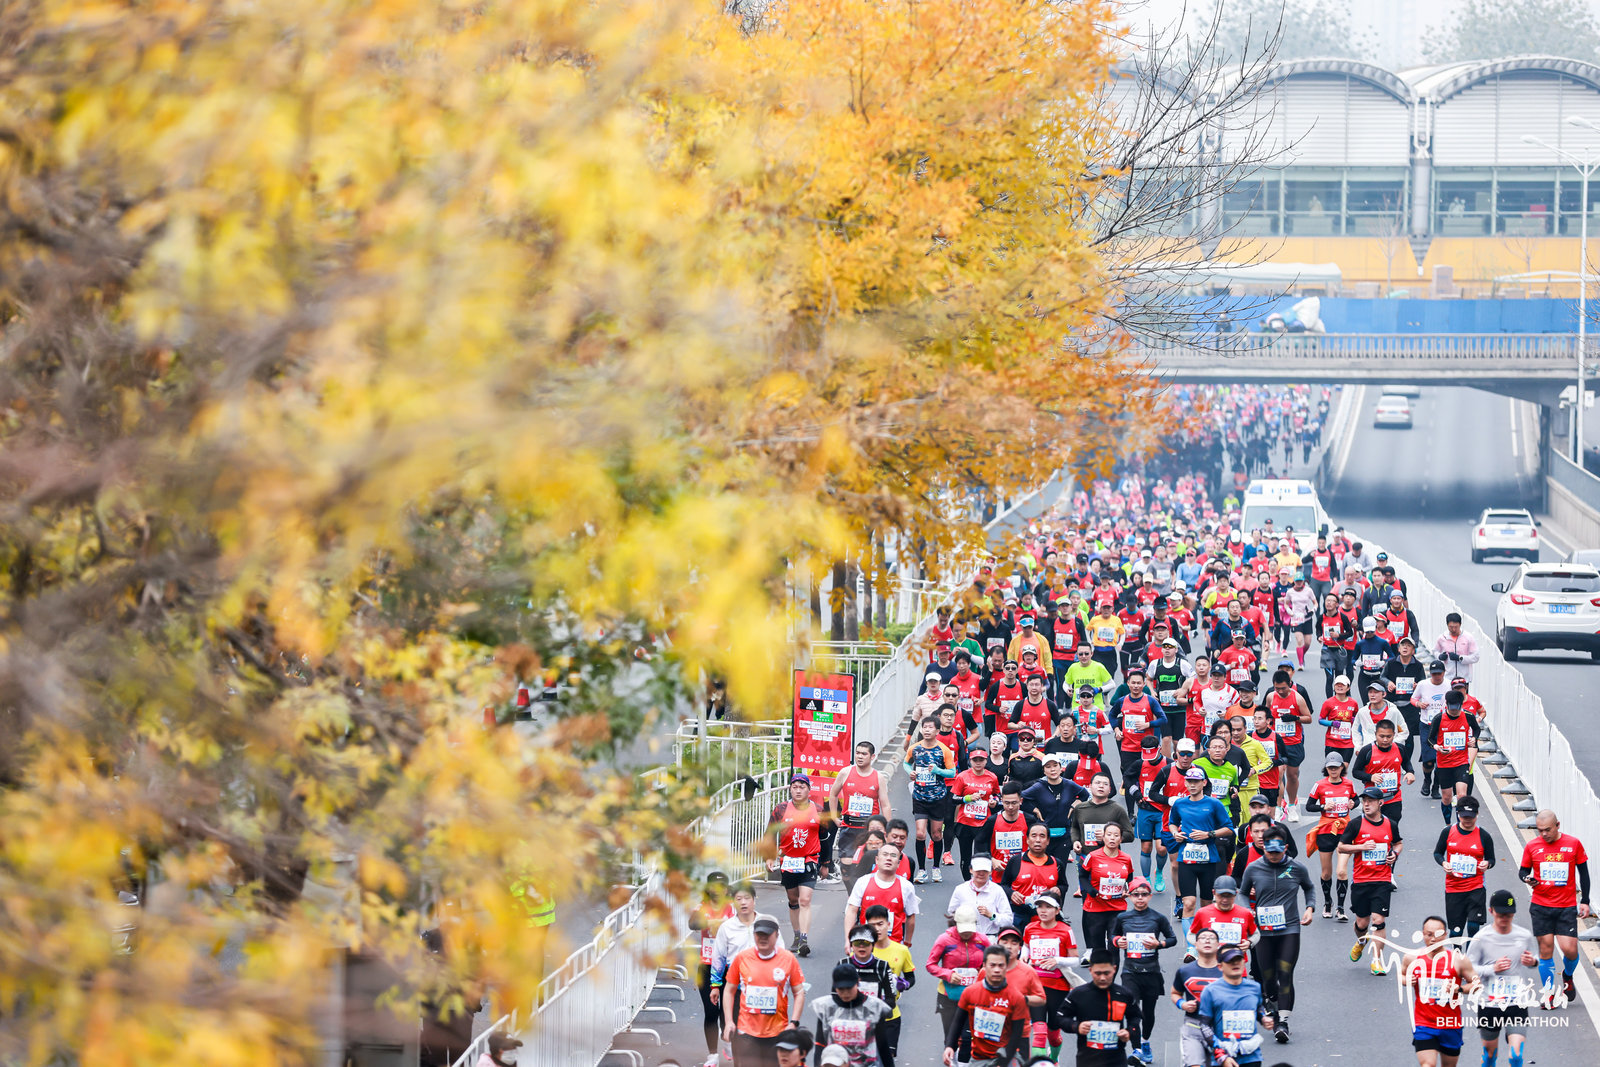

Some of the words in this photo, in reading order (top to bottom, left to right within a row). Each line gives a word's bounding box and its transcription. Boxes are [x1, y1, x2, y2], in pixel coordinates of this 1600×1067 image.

[1445, 738, 1464, 746] D1271
[965, 803, 987, 814] C9494
[1185, 850, 1208, 860] D0342
[1364, 850, 1386, 860] E0977
[1452, 862, 1475, 873] E0417
[1542, 869, 1566, 879] F1962
[1259, 913, 1283, 924] E1007
[1217, 930, 1239, 941] 2433
[1032, 947, 1057, 957] F9250
[975, 1017, 1000, 1033] F3452
